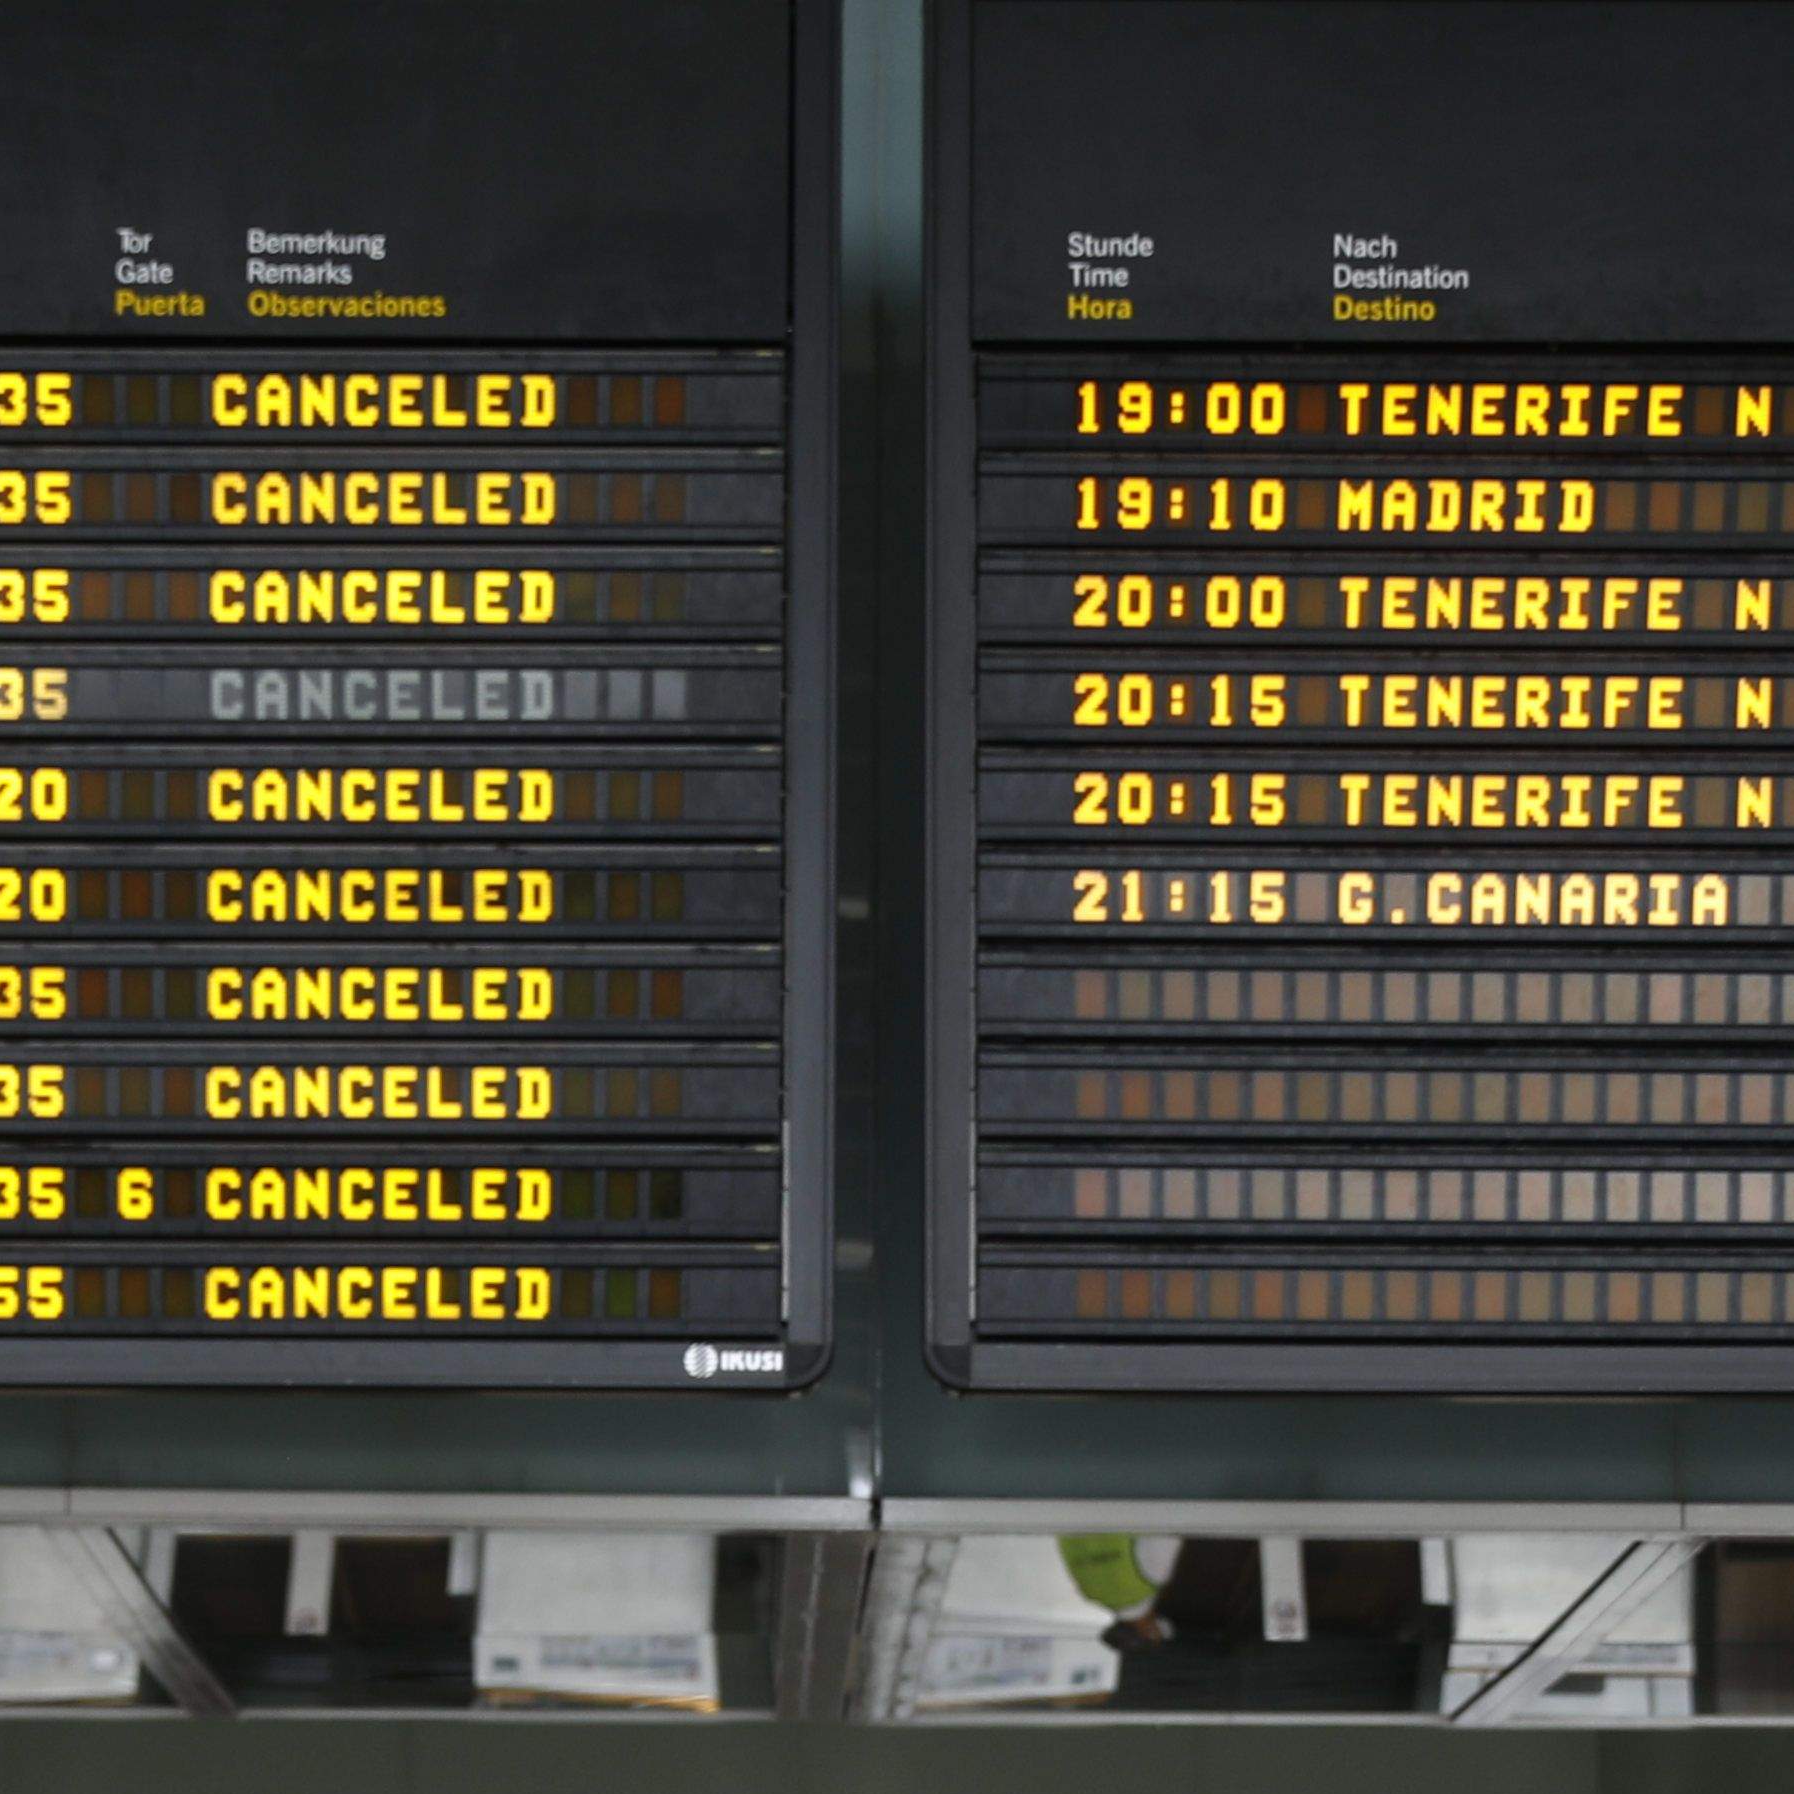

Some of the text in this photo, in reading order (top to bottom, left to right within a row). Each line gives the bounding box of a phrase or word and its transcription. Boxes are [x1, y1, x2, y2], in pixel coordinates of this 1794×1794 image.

[116, 227, 153, 254] Tor
[247, 228, 386, 259] Bemerkung
[1068, 231, 1154, 258] Stunde
[1333, 233, 1398, 259] Nach
[114, 258, 174, 284] Gate
[247, 258, 353, 285] Remarks
[1068, 261, 1129, 288] Time
[1333, 264, 1470, 290] Destination
[114, 289, 206, 317] Puerta
[247, 289, 447, 318] Observaciones
[1068, 293, 1133, 320] Hora
[1333, 294, 1437, 321] Destino
[211, 375, 554, 426] CANCELED
[1078, 383, 1284, 434] 19:00
[1339, 385, 1682, 436] TENERIFE
[1736, 388, 1770, 436] N
[1077, 478, 1284, 530] 19:10
[1337, 481, 1593, 532] MADRID
[1073, 576, 1284, 627] 20:00
[1339, 578, 1682, 630] TENERIFE
[1735, 581, 1770, 630] N
[211, 670, 554, 721] CANCELED
[207, 770, 552, 821] CANCELED
[1073, 773, 1284, 825] 20:15
[1339, 775, 1683, 827] TENERIFE
[1736, 778, 1771, 827] N
[1073, 871, 1284, 922] 21:15
[1338, 873, 1727, 925] G.CANARIA
[205, 969, 551, 1020] CANCELED
[115, 1169, 152, 1219] 6
[204, 1169, 550, 1220] CANCELED
[203, 1268, 549, 1319] CANCELED
[719, 1351, 784, 1372] IKUSI
